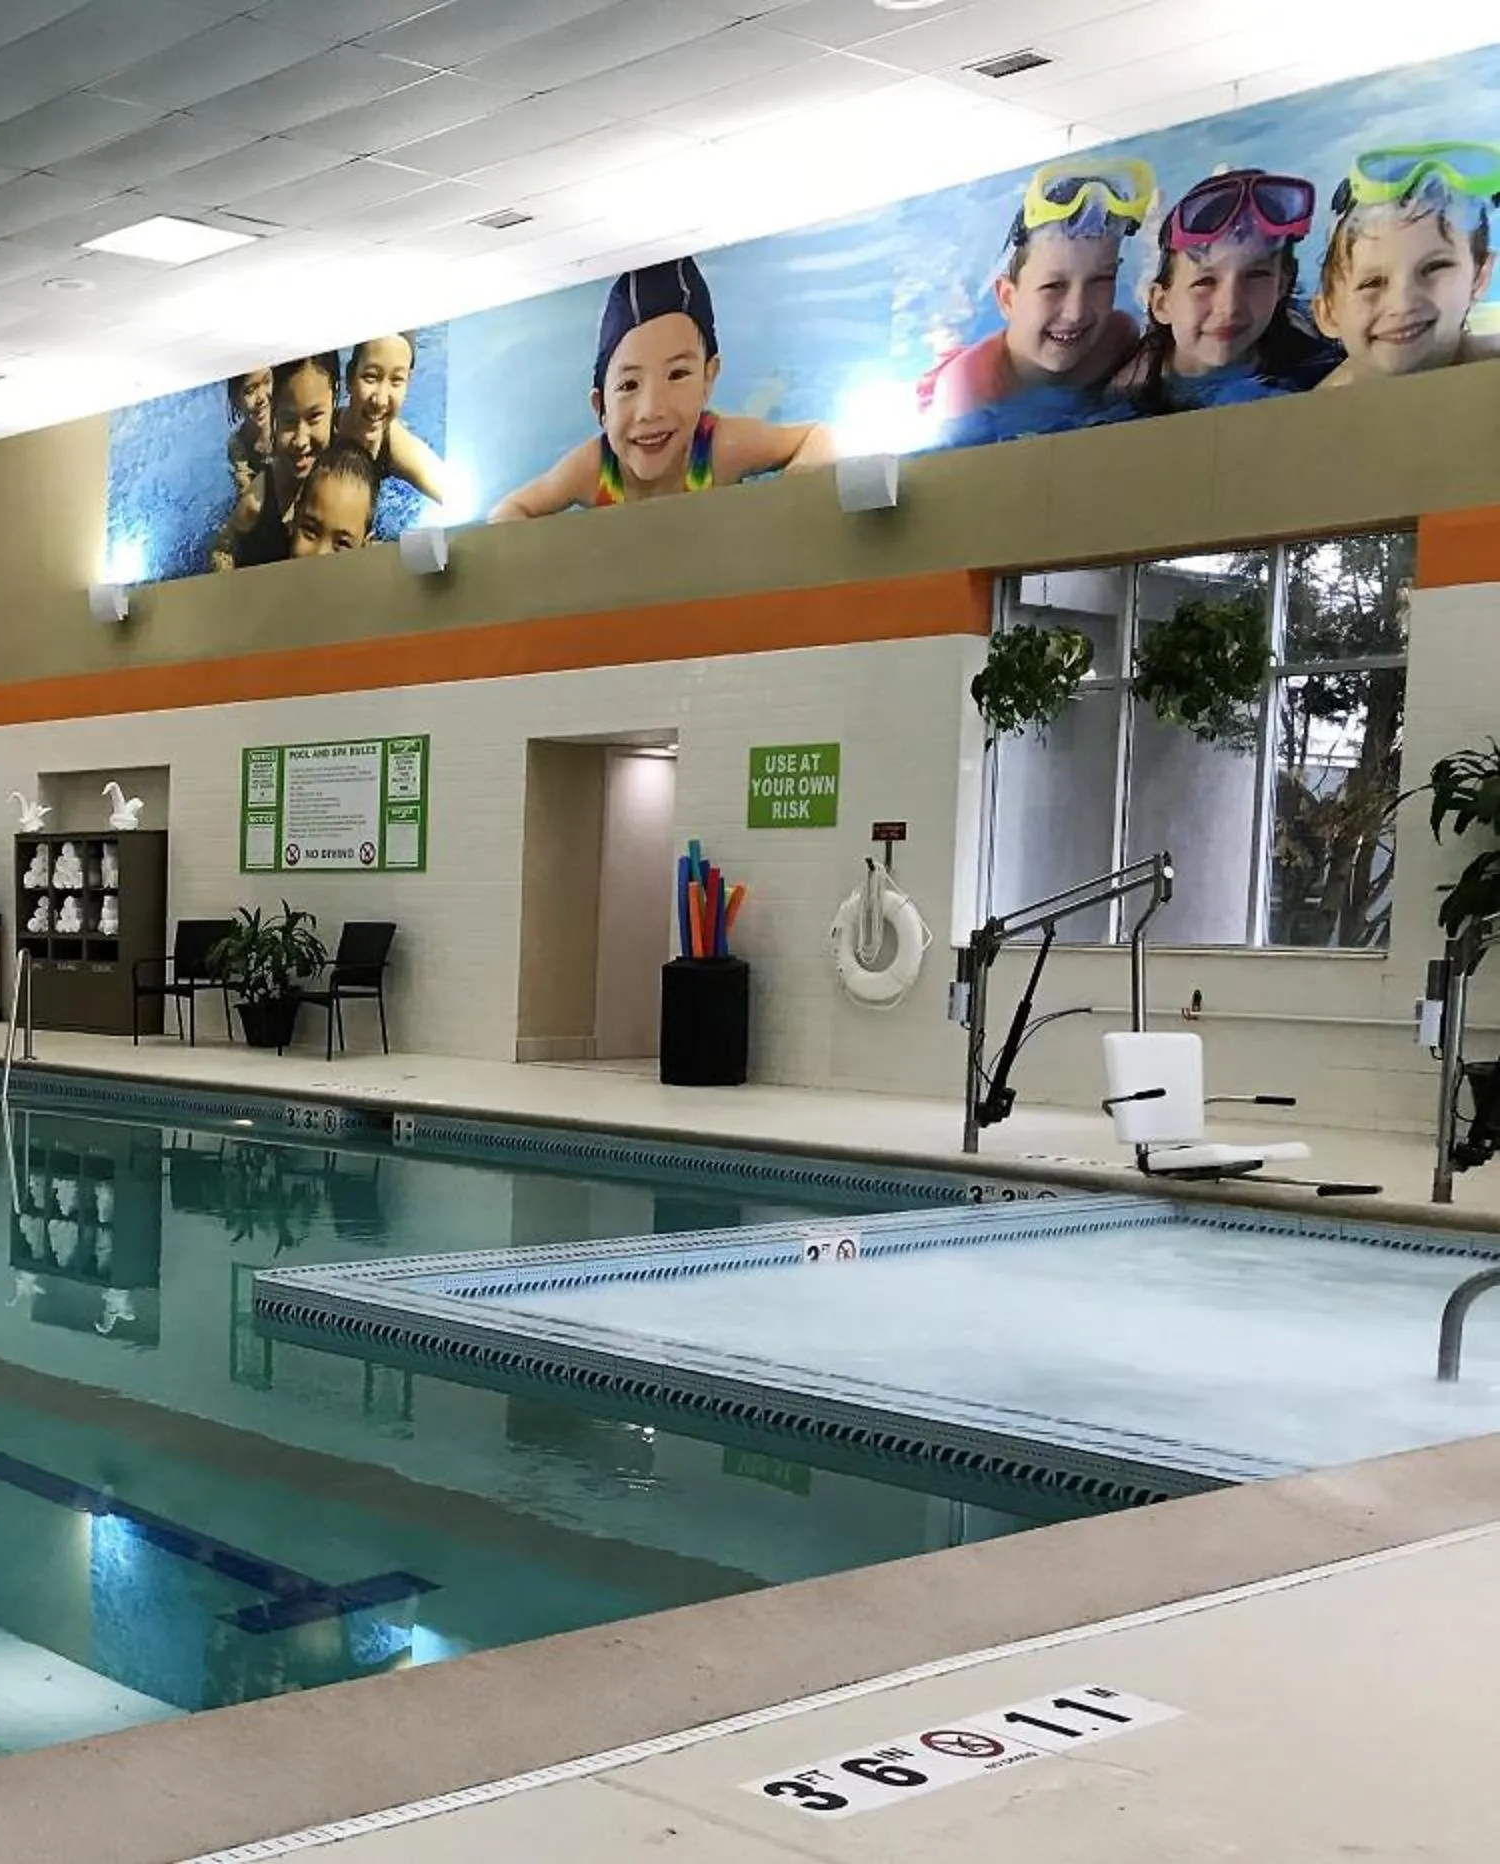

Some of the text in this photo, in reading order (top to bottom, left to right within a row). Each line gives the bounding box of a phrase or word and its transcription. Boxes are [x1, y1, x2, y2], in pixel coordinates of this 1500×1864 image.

[765, 753, 821, 773] USE AT
[752, 775, 836, 797] YOUR OWN
[772, 800, 811, 819] RISK
[305, 849, 319, 859] NO
